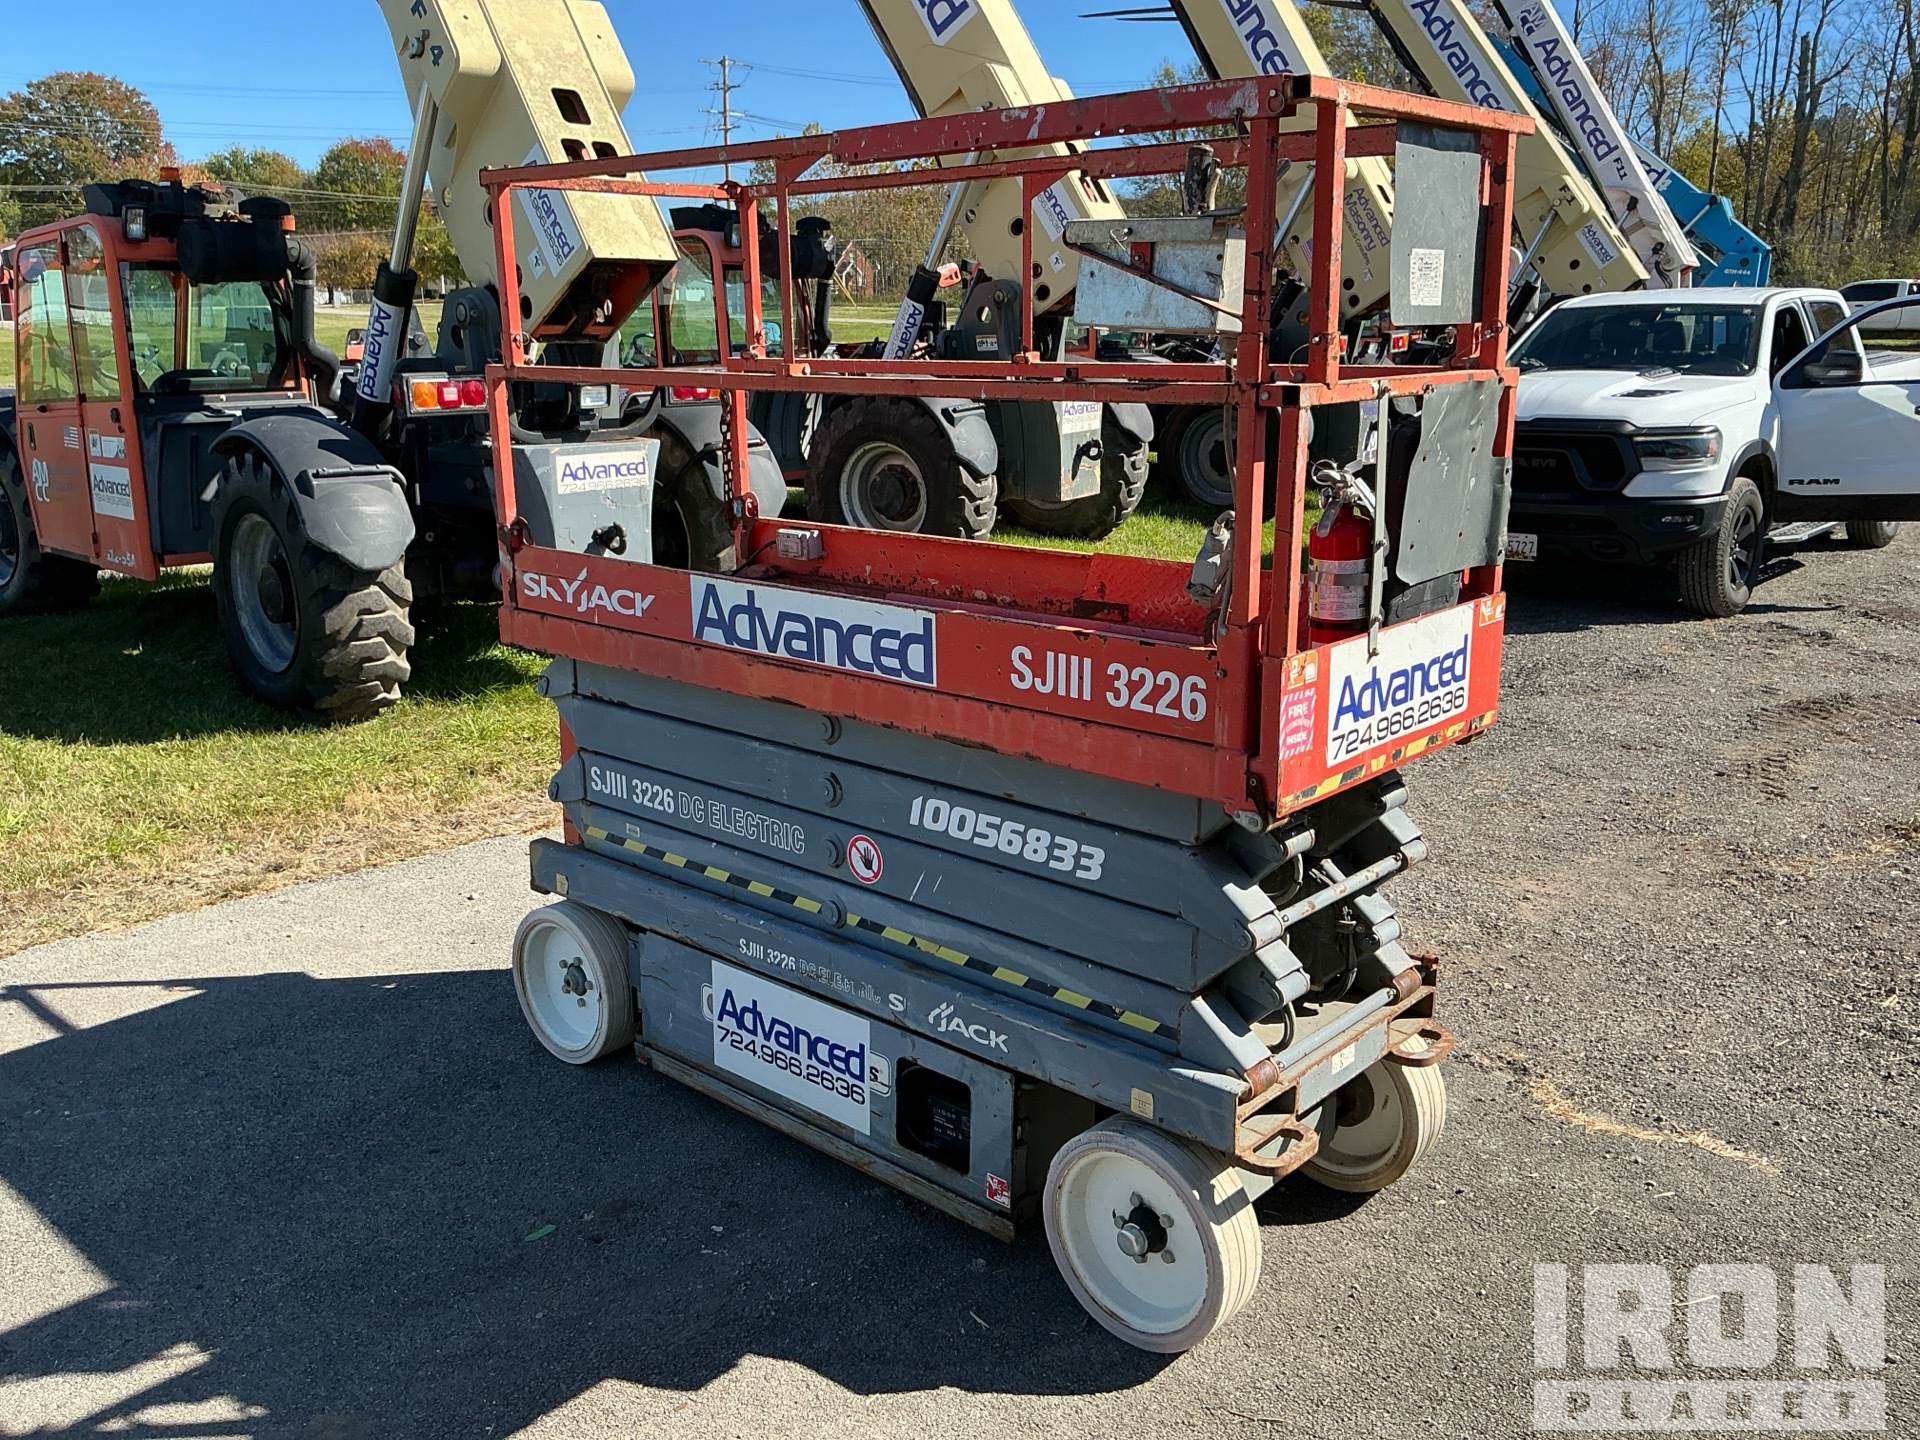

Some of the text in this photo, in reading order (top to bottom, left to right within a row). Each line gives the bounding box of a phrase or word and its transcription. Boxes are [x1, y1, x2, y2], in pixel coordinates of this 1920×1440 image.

[430, 45, 444, 67] 4
[1225, 0, 1294, 75] ance
[1410, 0, 1505, 110] Advance
[1534, 37, 1619, 162] Advanced
[1613, 157, 1628, 181] F11
[1043, 187, 1069, 229] ance
[1343, 193, 1377, 252] Masonry
[1353, 187, 1390, 247] Advanced
[1584, 224, 1614, 262] Advanced
[362, 303, 392, 399] Advanced
[1063, 403, 1099, 416] Advanced
[93, 474, 131, 497] Advanced
[561, 456, 646, 482] Advanced
[1788, 478, 1841, 486] RAM
[695, 583, 933, 684] Advanced
[1010, 645, 1207, 722] SJIII 3226
[1288, 701, 1309, 719] FIRE
[1332, 633, 1469, 731] Advanced
[1332, 686, 1465, 761] 724.966.2636
[591, 766, 805, 854] SJIII 3226 DC ELECTRIC
[909, 795, 1105, 881] 10056833
[739, 938, 764, 960] SJIII
[767, 948, 796, 971] 3226
[717, 988, 866, 1084] Advanced
[717, 1024, 866, 1106] 724.966.2636
